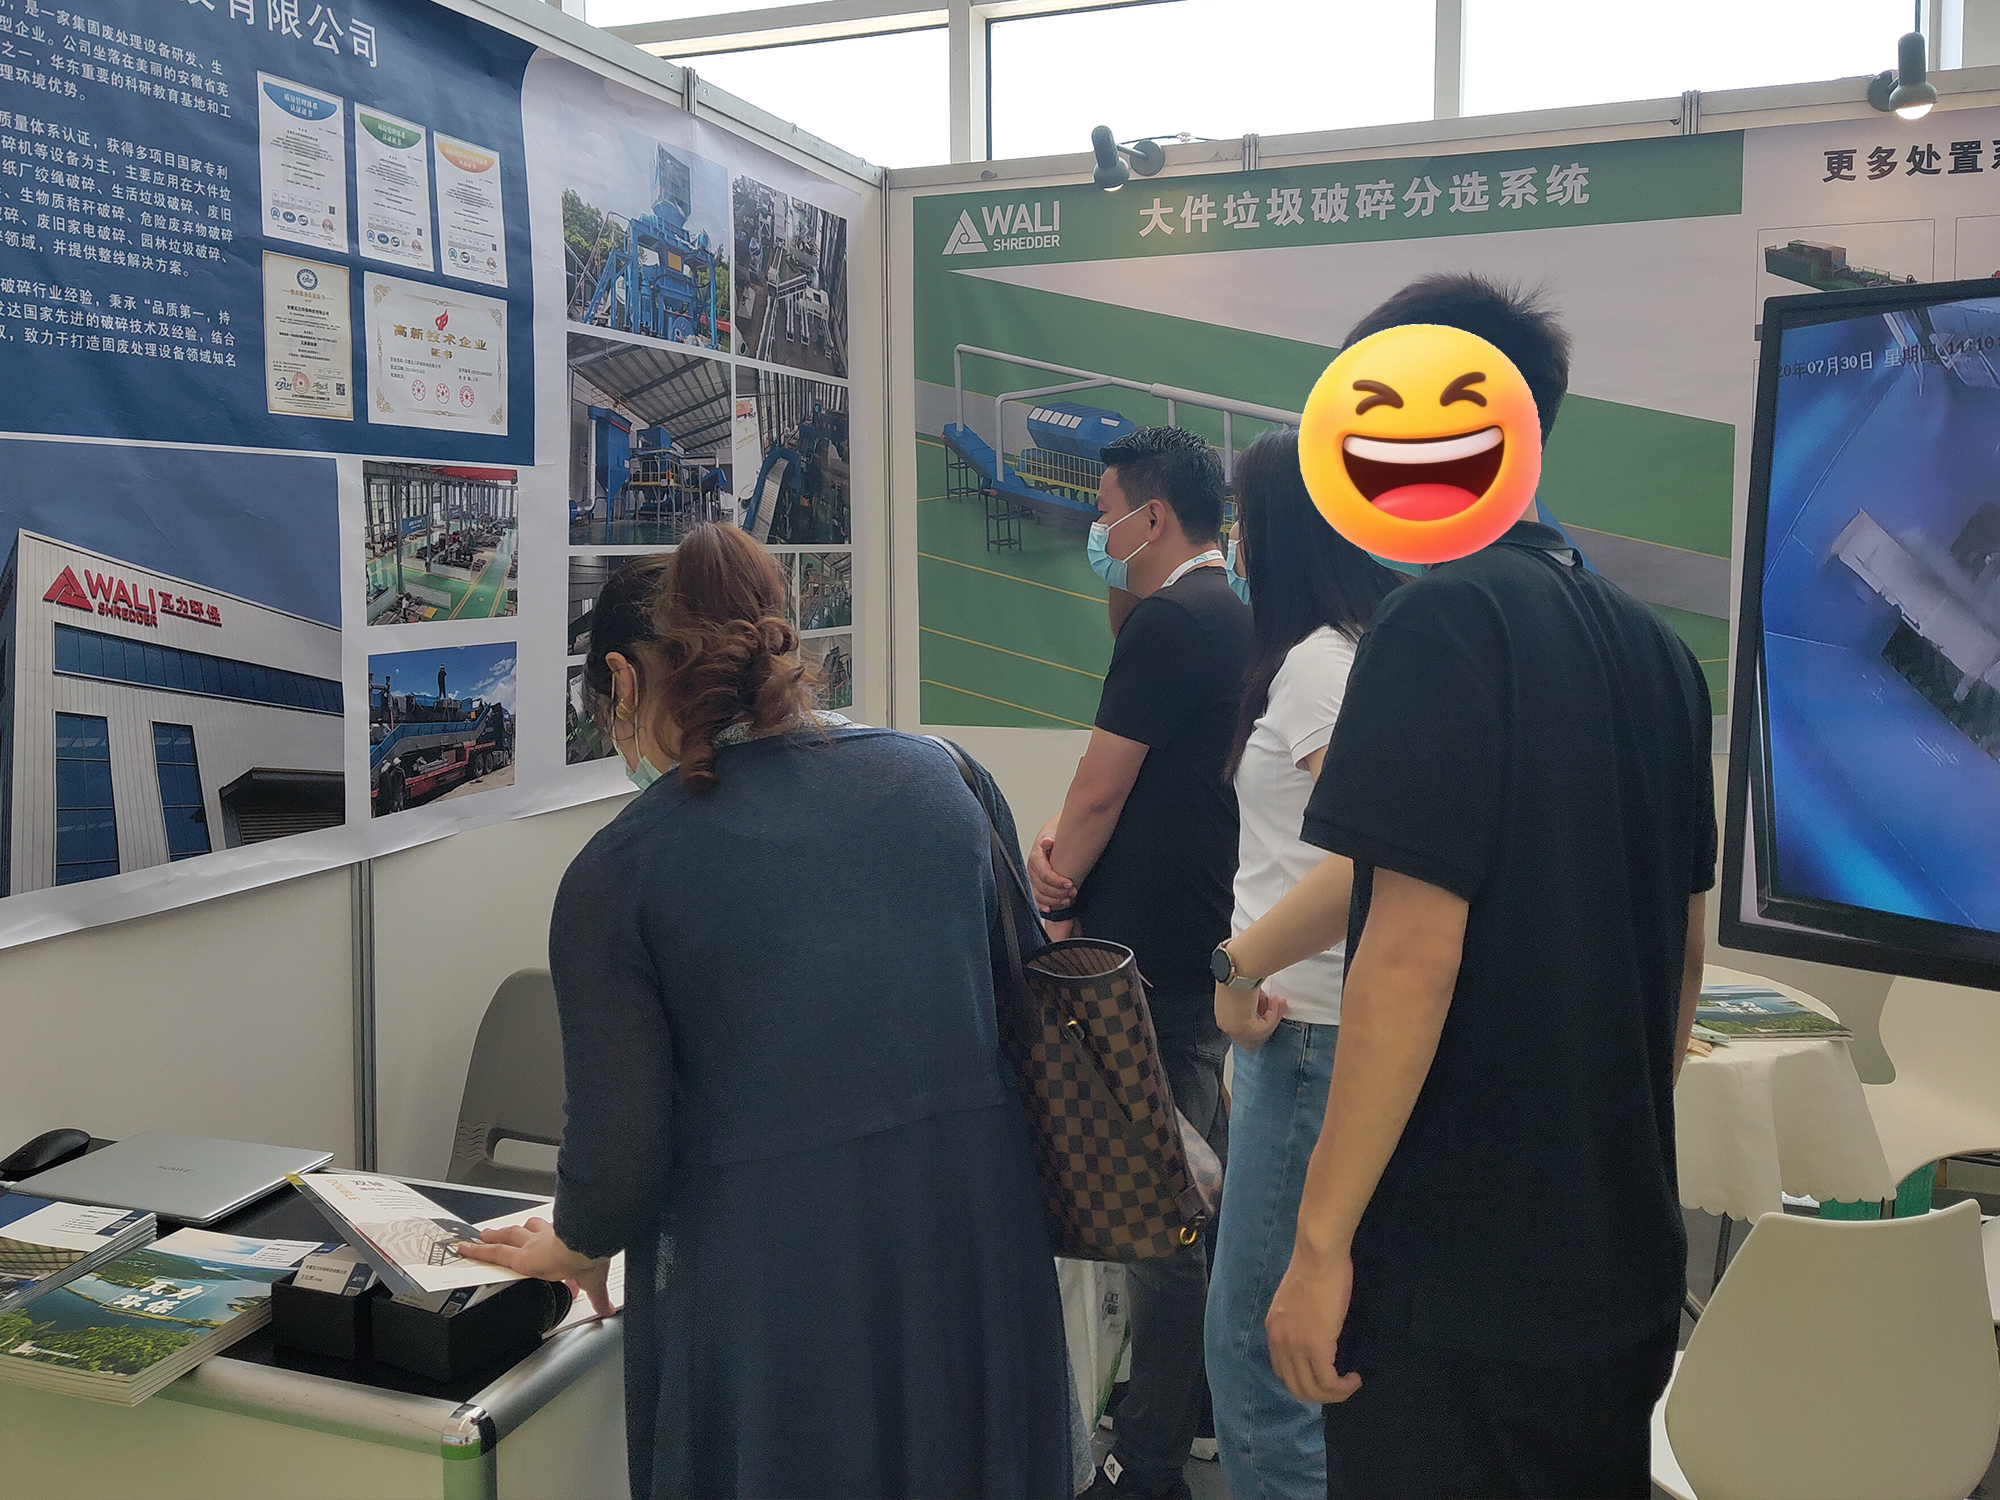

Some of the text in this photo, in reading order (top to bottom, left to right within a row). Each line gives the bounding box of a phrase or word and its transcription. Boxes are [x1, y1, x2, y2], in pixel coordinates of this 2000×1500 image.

[1, 40, 232, 119] 之一，华东重要的科研教育基地和工
[1, 134, 232, 202] 碎机等设备为主，主要应用在大件垃
[2, 159, 232, 222] 纸厂绞绳破碎、生活垃圾破碎、废旧
[1138, 162, 1591, 238] 大件垃圾破碎分选系统
[981, 200, 1060, 236] WALI
[992, 234, 1060, 252] SHREDDER
[393, 324, 487, 351] 高新技术企业
[84, 569, 156, 614] WALI
[158, 590, 221, 622] 瓦力环保
[97, 601, 158, 628] SHREDDER
[326, 1178, 361, 1202] DOUBLE
